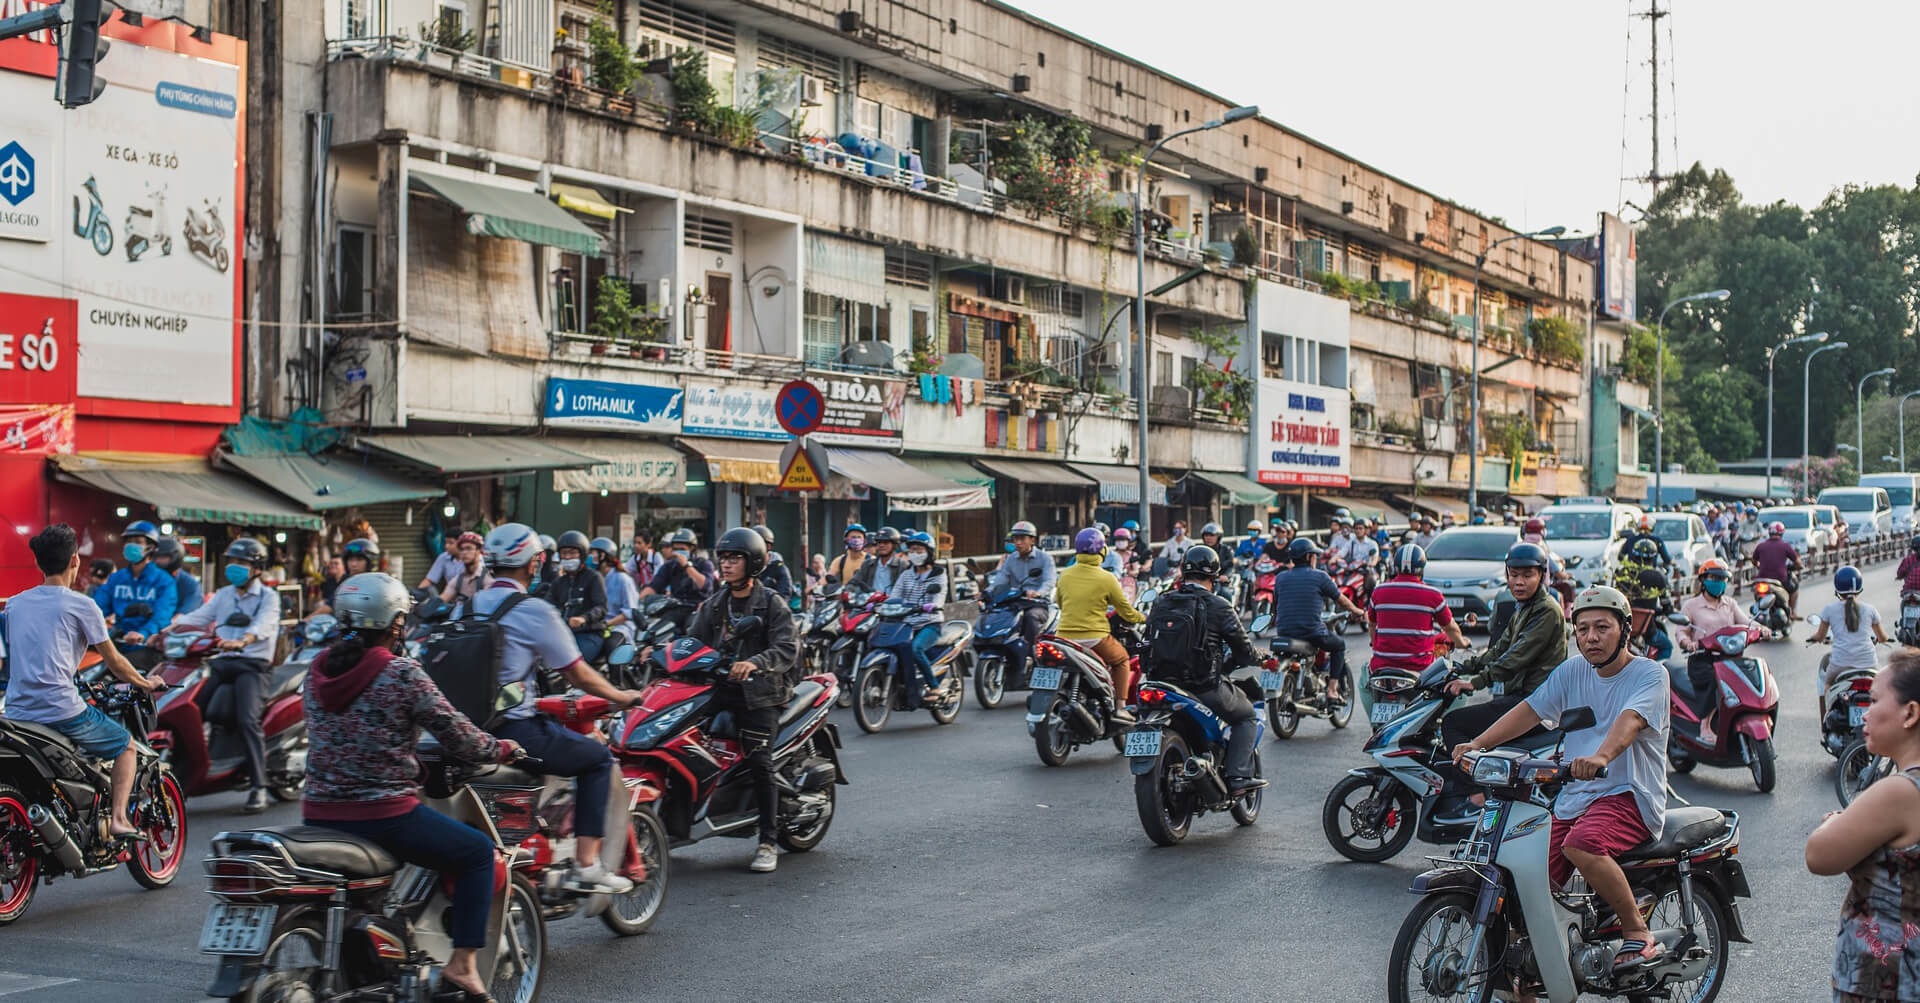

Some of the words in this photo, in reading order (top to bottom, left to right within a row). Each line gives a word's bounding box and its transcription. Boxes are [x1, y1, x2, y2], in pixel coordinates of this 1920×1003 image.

[106, 144, 120, 160] XE
[122, 148, 138, 163] GA
[148, 152, 161, 167] XE
[0, 209, 39, 227] IAGGIO
[21, 317, 58, 372] SỐ
[830, 378, 883, 403] HÒA
[572, 395, 635, 415] LOTHAMILK
